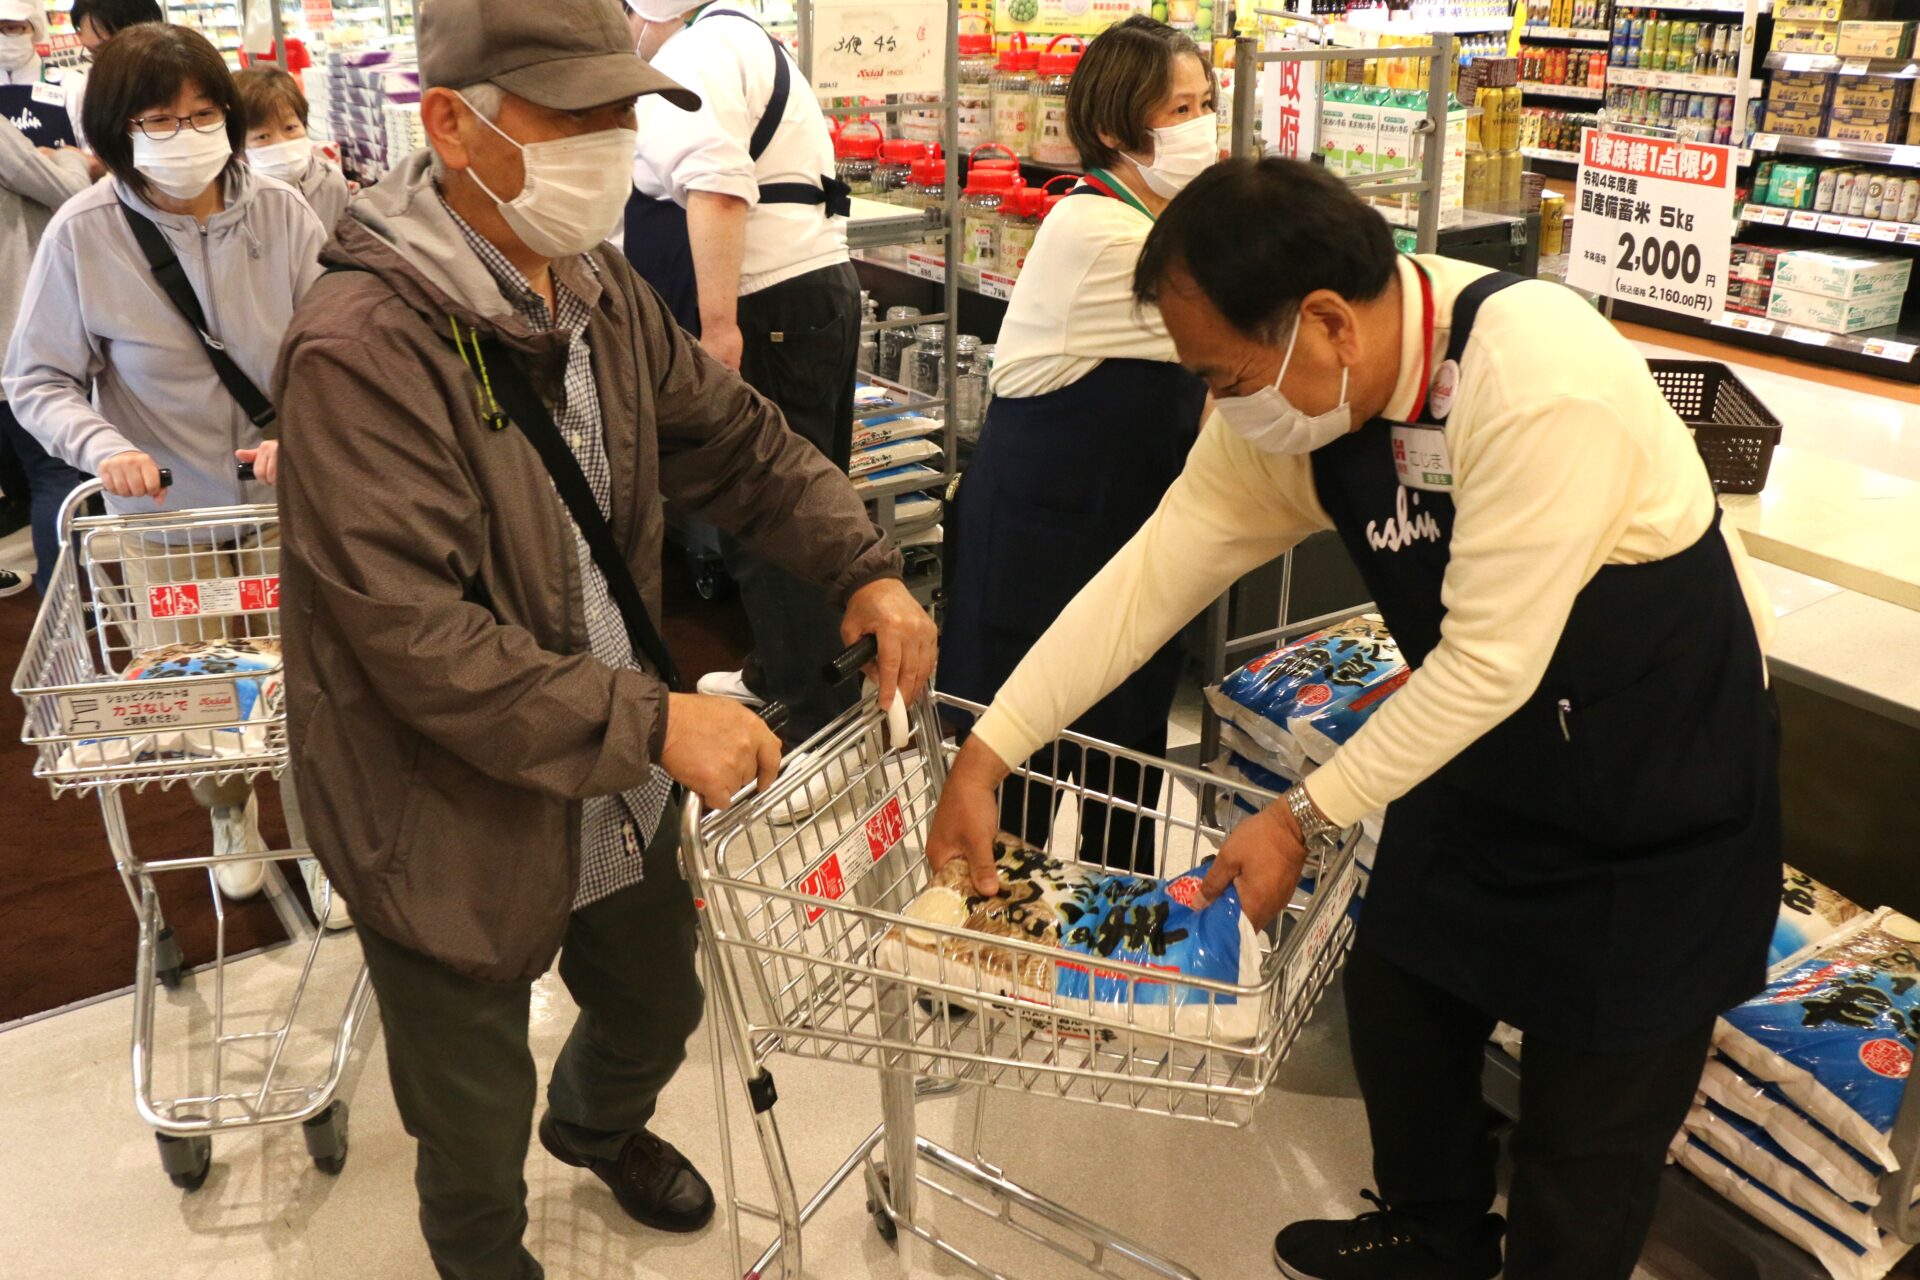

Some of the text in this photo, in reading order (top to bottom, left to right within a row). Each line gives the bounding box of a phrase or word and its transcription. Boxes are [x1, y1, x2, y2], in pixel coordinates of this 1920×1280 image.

[857, 68, 884, 78] Axial
[1590, 137, 1718, 181] 1家族様1点限り
[1583, 170, 1638, 195] 令和4年度産
[1581, 189, 1696, 232] 国産備蓄米 5kg
[1583, 250, 1607, 265] 本体価格
[106, 689, 189, 704] ショッピングカートは
[113, 700, 188, 717] カゴなしで
[123, 714, 181, 727] ご利用ください
